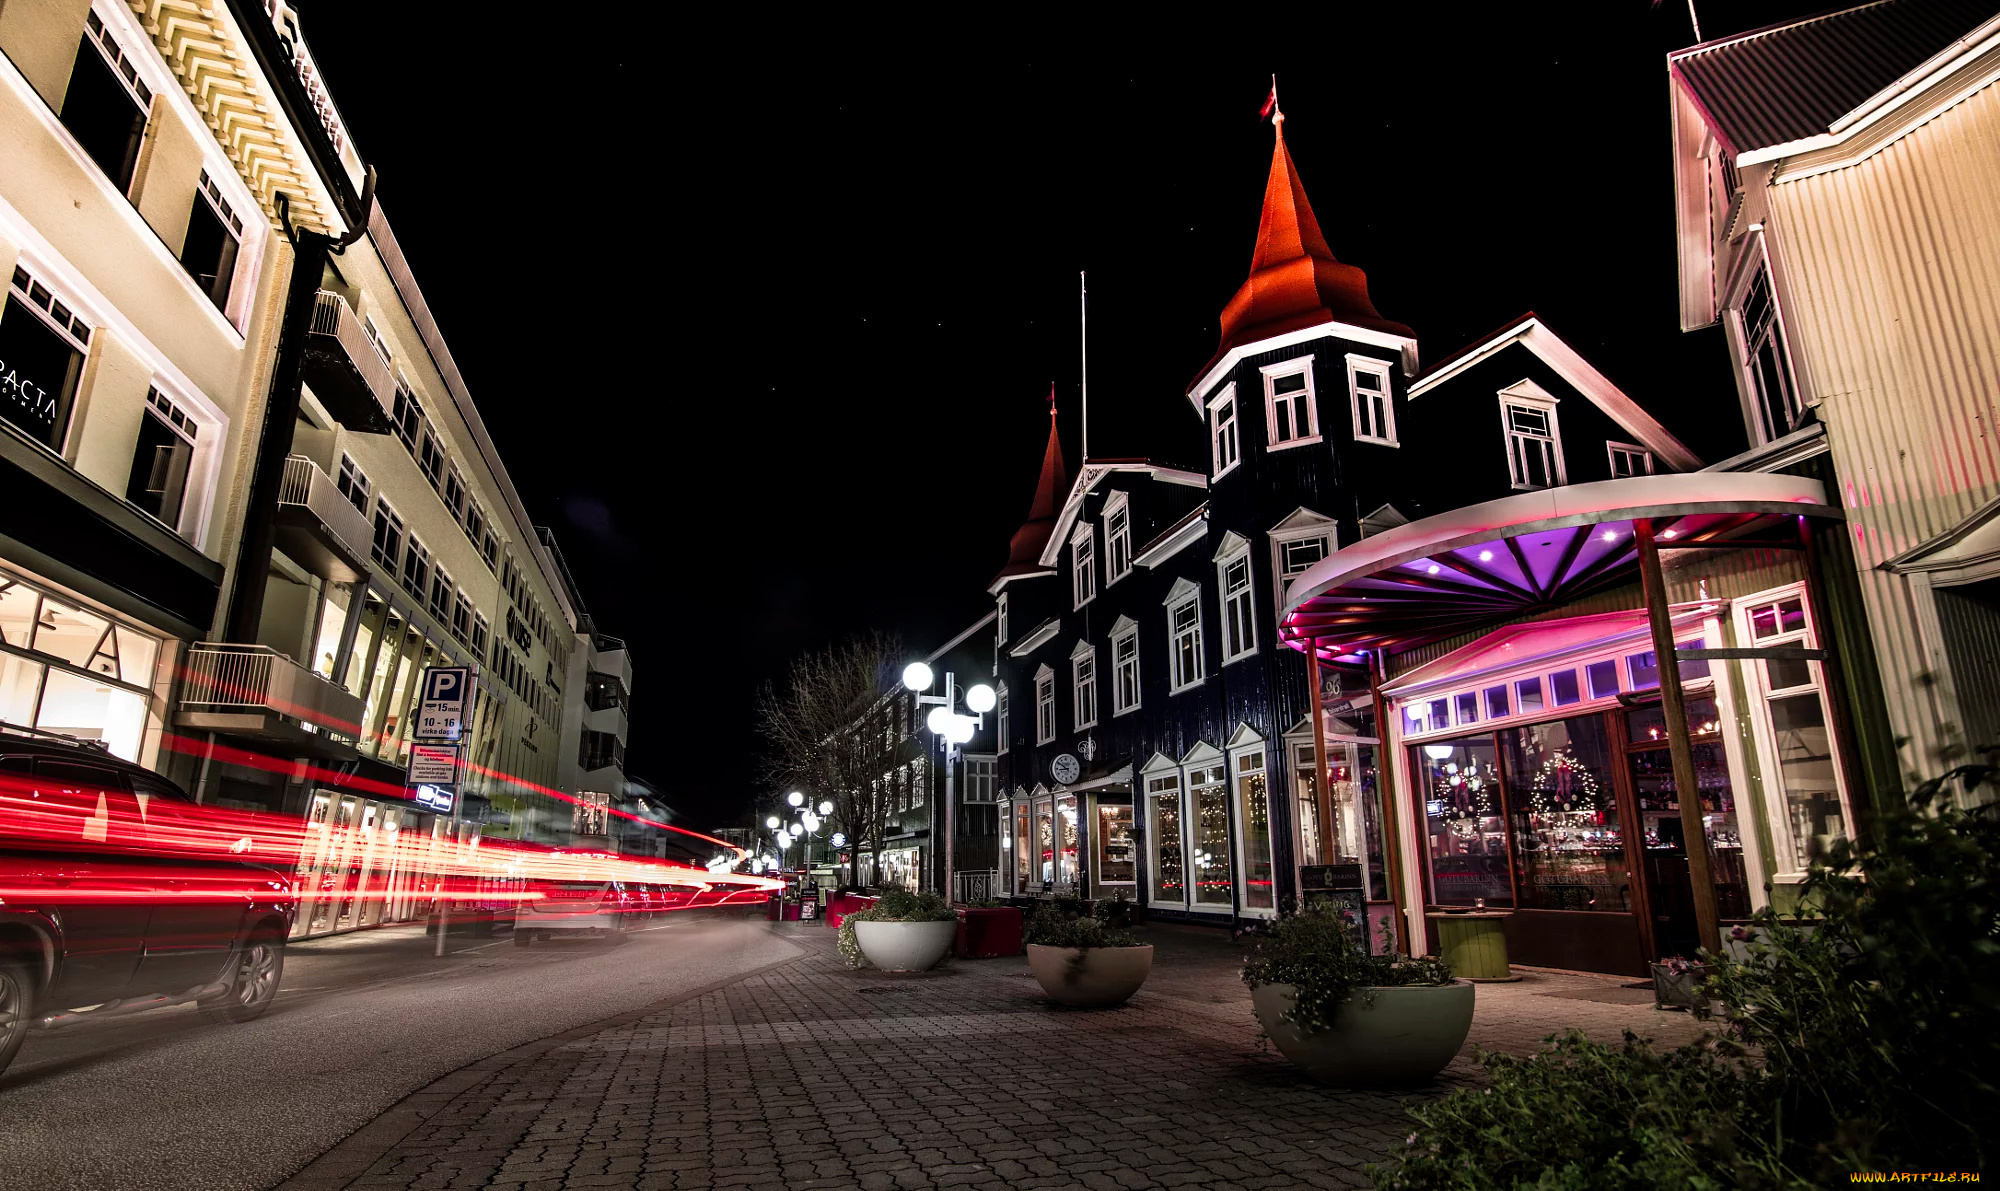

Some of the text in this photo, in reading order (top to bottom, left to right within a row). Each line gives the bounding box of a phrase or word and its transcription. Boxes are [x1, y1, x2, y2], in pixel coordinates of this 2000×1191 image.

[433, 673, 456, 699] P
[437, 703, 448, 711] 15
[424, 717, 435, 727] 10
[444, 718, 455, 727] 16
